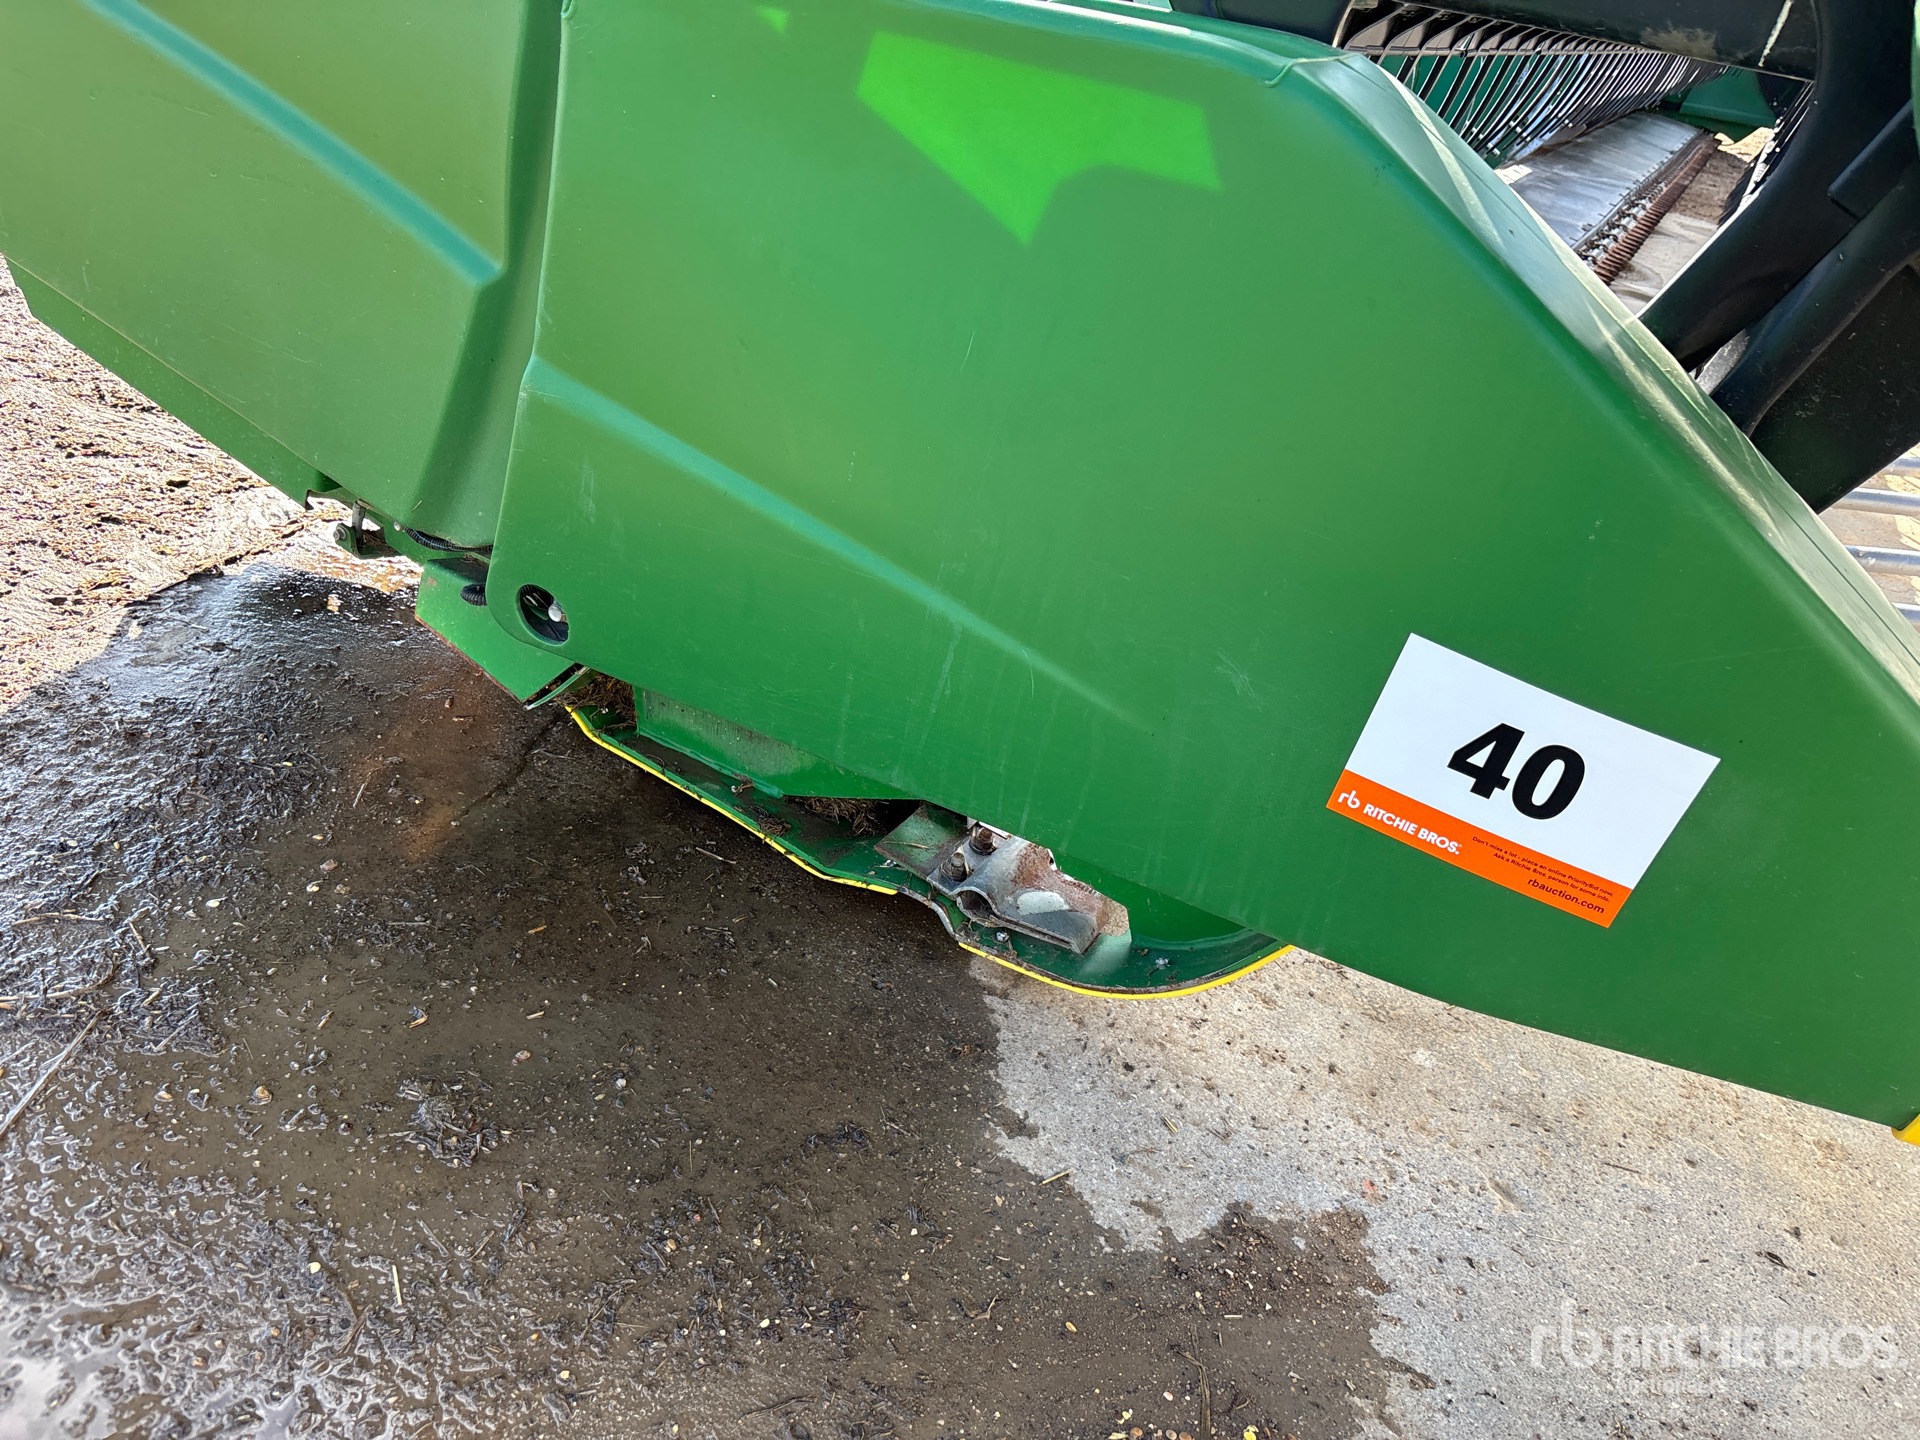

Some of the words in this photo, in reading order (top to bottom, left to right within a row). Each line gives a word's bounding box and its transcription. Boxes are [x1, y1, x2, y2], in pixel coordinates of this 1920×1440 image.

[1447, 722, 1585, 820] 40
[1337, 790, 1360, 809] rb
[1363, 803, 1418, 835] RITCHIE
[1472, 836, 1489, 846] Don't
[1489, 843, 1503, 853] miss
[1508, 850, 1518, 858] lot
[1520, 857, 1538, 867] place
[1547, 867, 1567, 878] online
[1567, 874, 1600, 891] PriorityBid
[1493, 852, 1505, 861] Ask
[1510, 859, 1531, 871] Ritchie
[1532, 867, 1547, 878] Bros.
[1547, 875, 1569, 886] person
[1570, 882, 1579, 890] for
[1579, 887, 1597, 897] some
[1596, 893, 1610, 902] info.
[1527, 878, 1605, 914] rbauction.com
